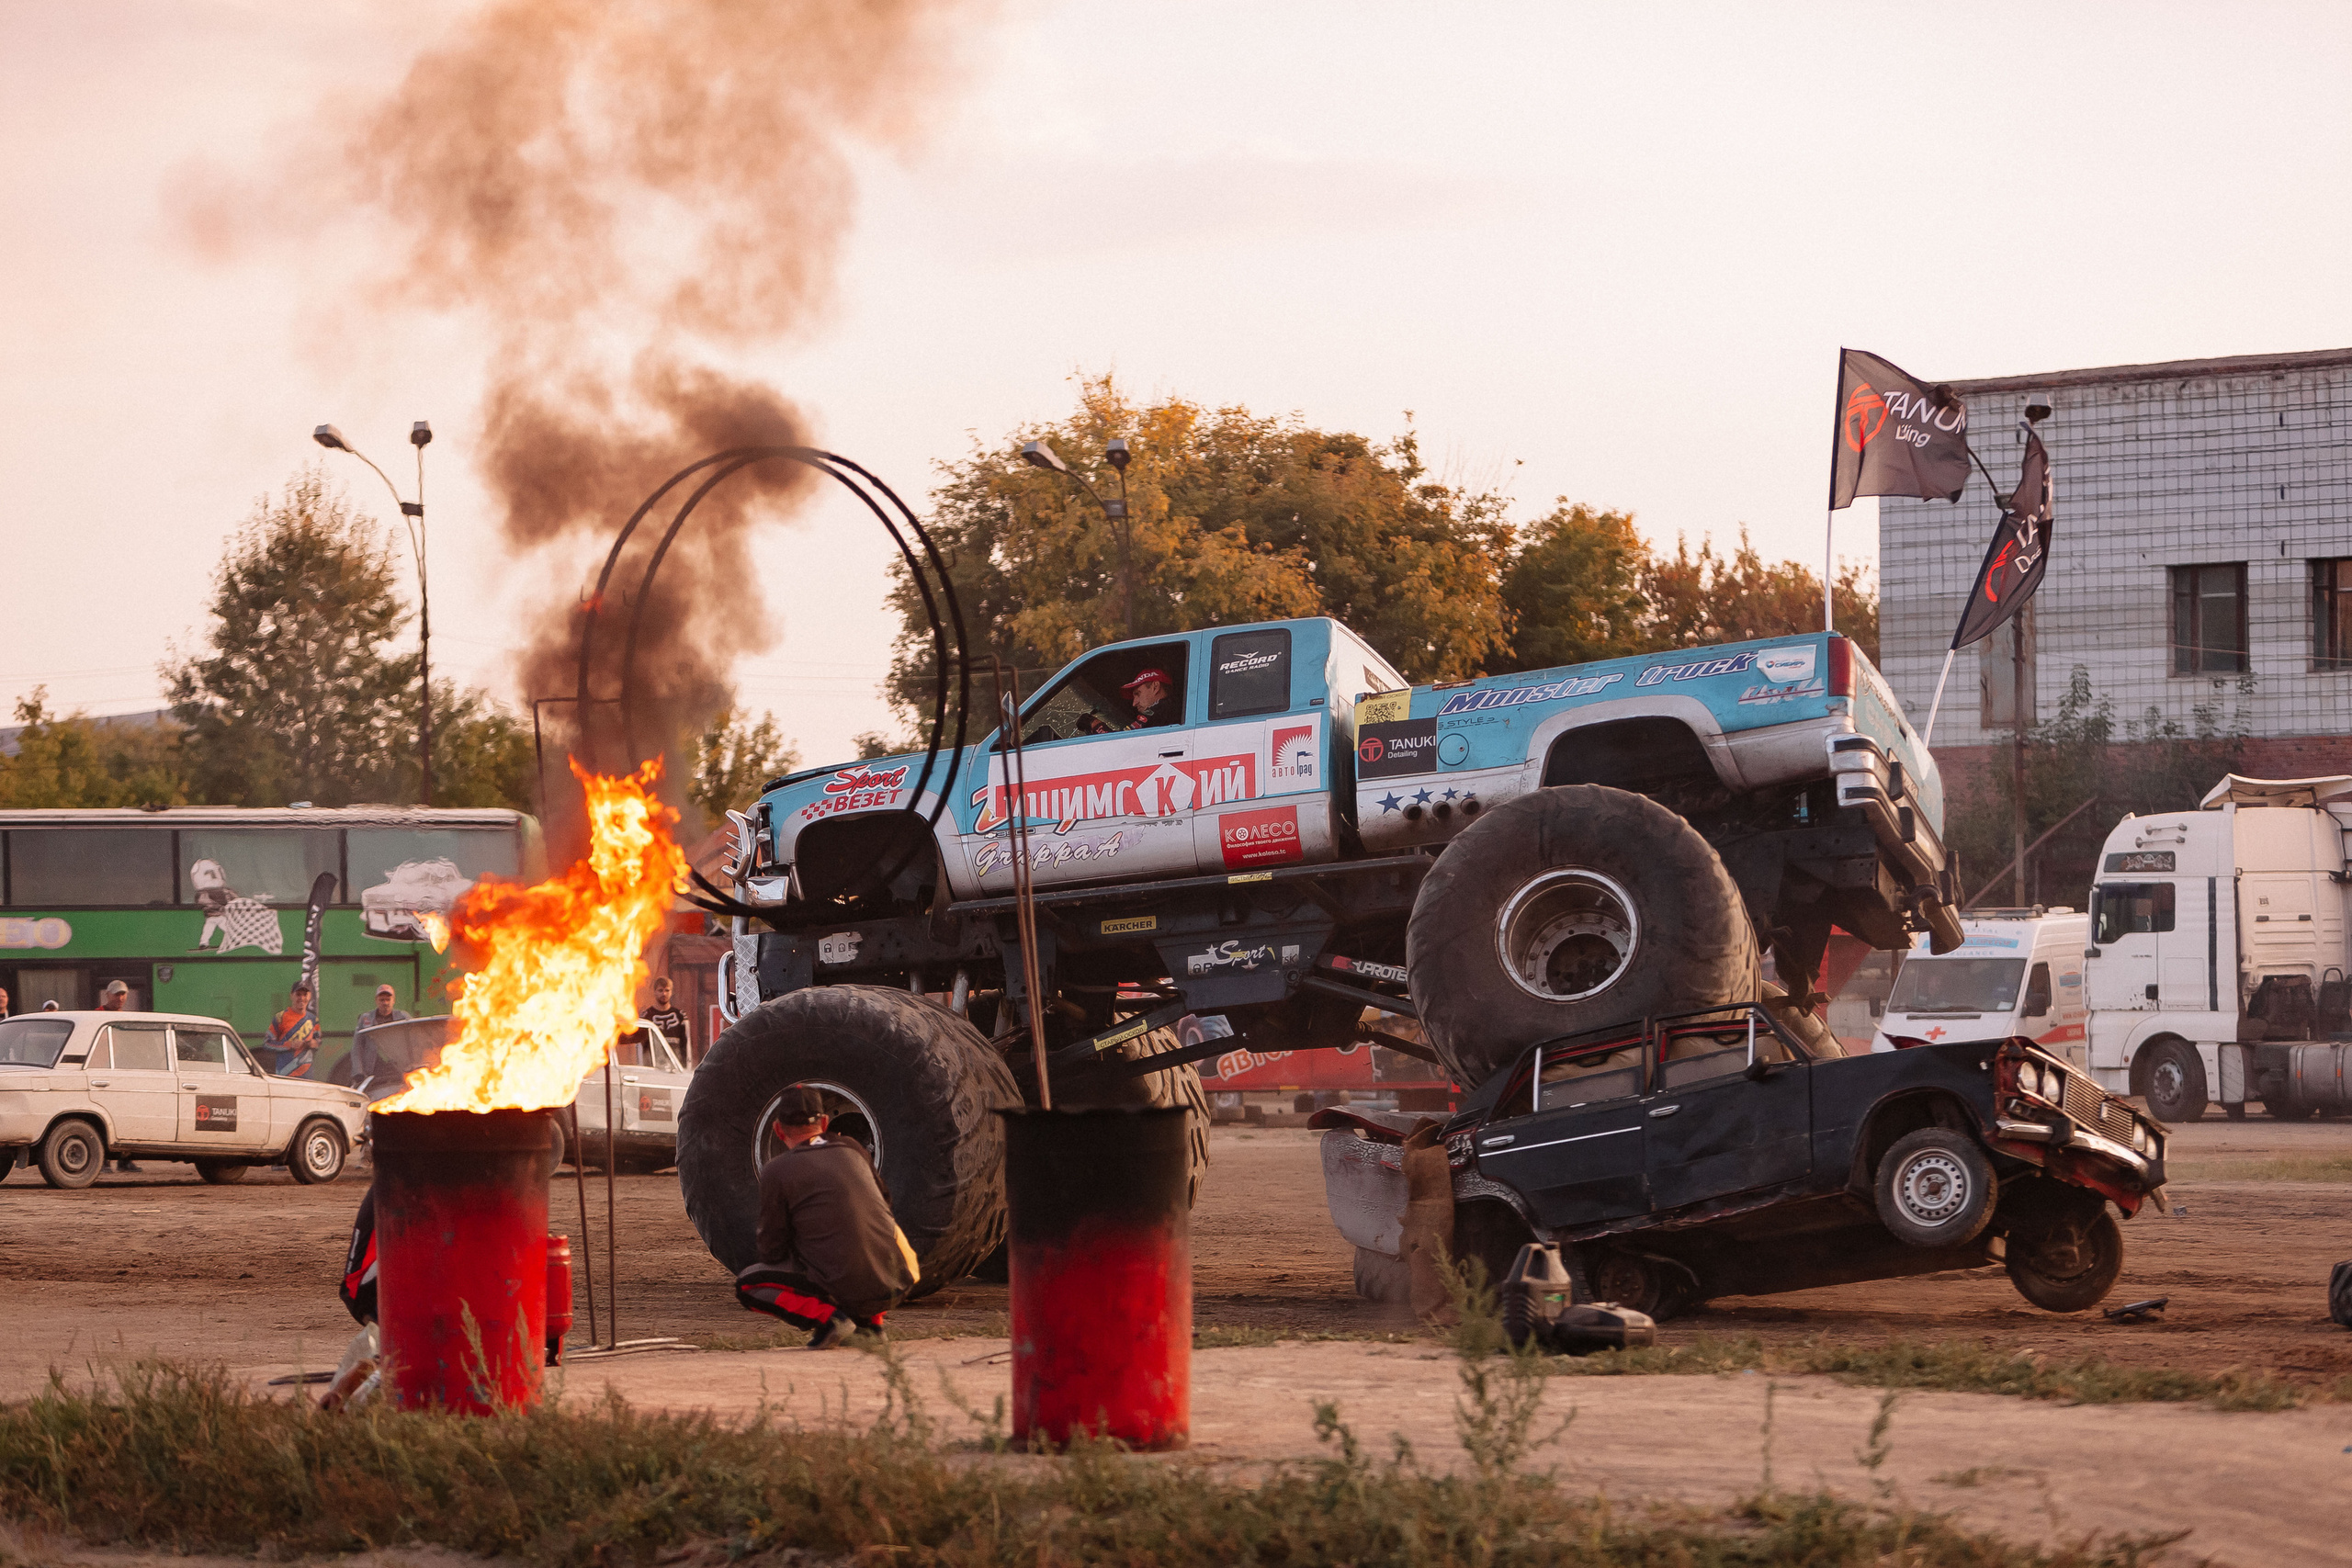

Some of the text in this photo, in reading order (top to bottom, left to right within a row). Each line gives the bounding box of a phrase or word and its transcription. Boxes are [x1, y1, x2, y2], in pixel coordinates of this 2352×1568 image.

[1883, 390, 1968, 434] TANU
[1220, 654, 1278, 671] RECORD
[1250, 662, 1270, 671] RADIO
[1438, 651, 1758, 716] Monster truck
[1389, 735, 1436, 750] TANUKI
[1387, 750, 1418, 759] Detailing
[824, 764, 910, 796] Sport
[833, 789, 903, 812] ВЕЗЕТ
[1224, 820, 1295, 843] КОЛЕСО
[1227, 840, 1254, 849] Философия
[1272, 836, 1296, 844] движения
[1242, 849, 1286, 859] www.koleso.tc
